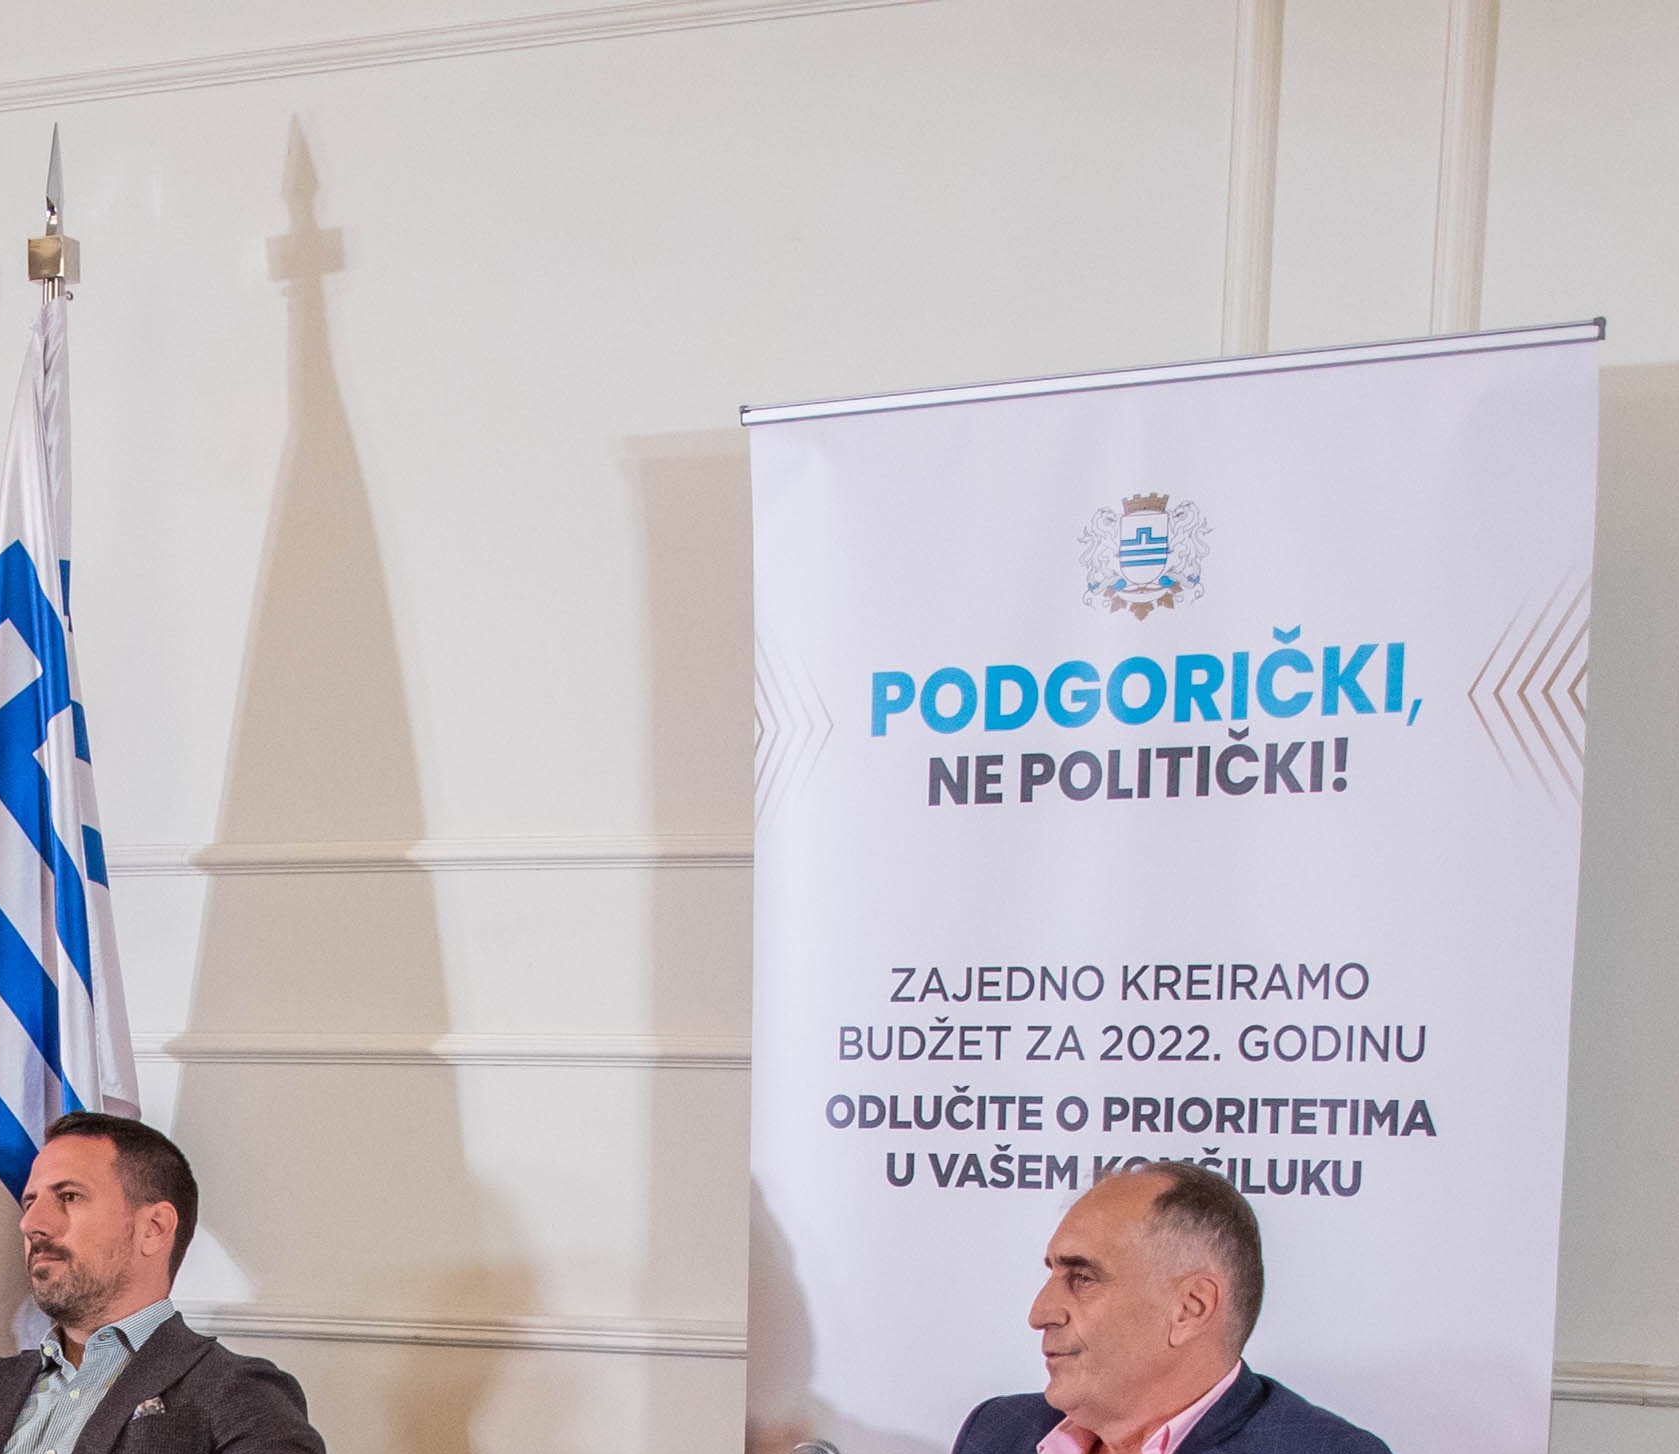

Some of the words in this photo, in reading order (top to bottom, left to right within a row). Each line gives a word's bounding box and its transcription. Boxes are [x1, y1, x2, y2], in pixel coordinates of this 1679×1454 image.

[870, 624, 1423, 738] PODGORIČKI,
[928, 754, 1004, 806] NE
[1019, 726, 1349, 804] POLITIČKI!
[889, 964, 1105, 1003] ZAJEDNO
[1120, 962, 1370, 1001] KREIRAMO
[838, 1016, 1012, 1062] BUDŽET
[1025, 1025, 1086, 1062] ZA
[1099, 1024, 1222, 1062] 2022.
[1237, 1023, 1427, 1064] GODINU
[825, 1085, 1044, 1132] ODLUČITE
[1055, 1095, 1090, 1133] O
[1102, 1095, 1438, 1137] PRIORITETIMA
[885, 1152, 916, 1189] U
[928, 1144, 1079, 1190] VAŠEM
